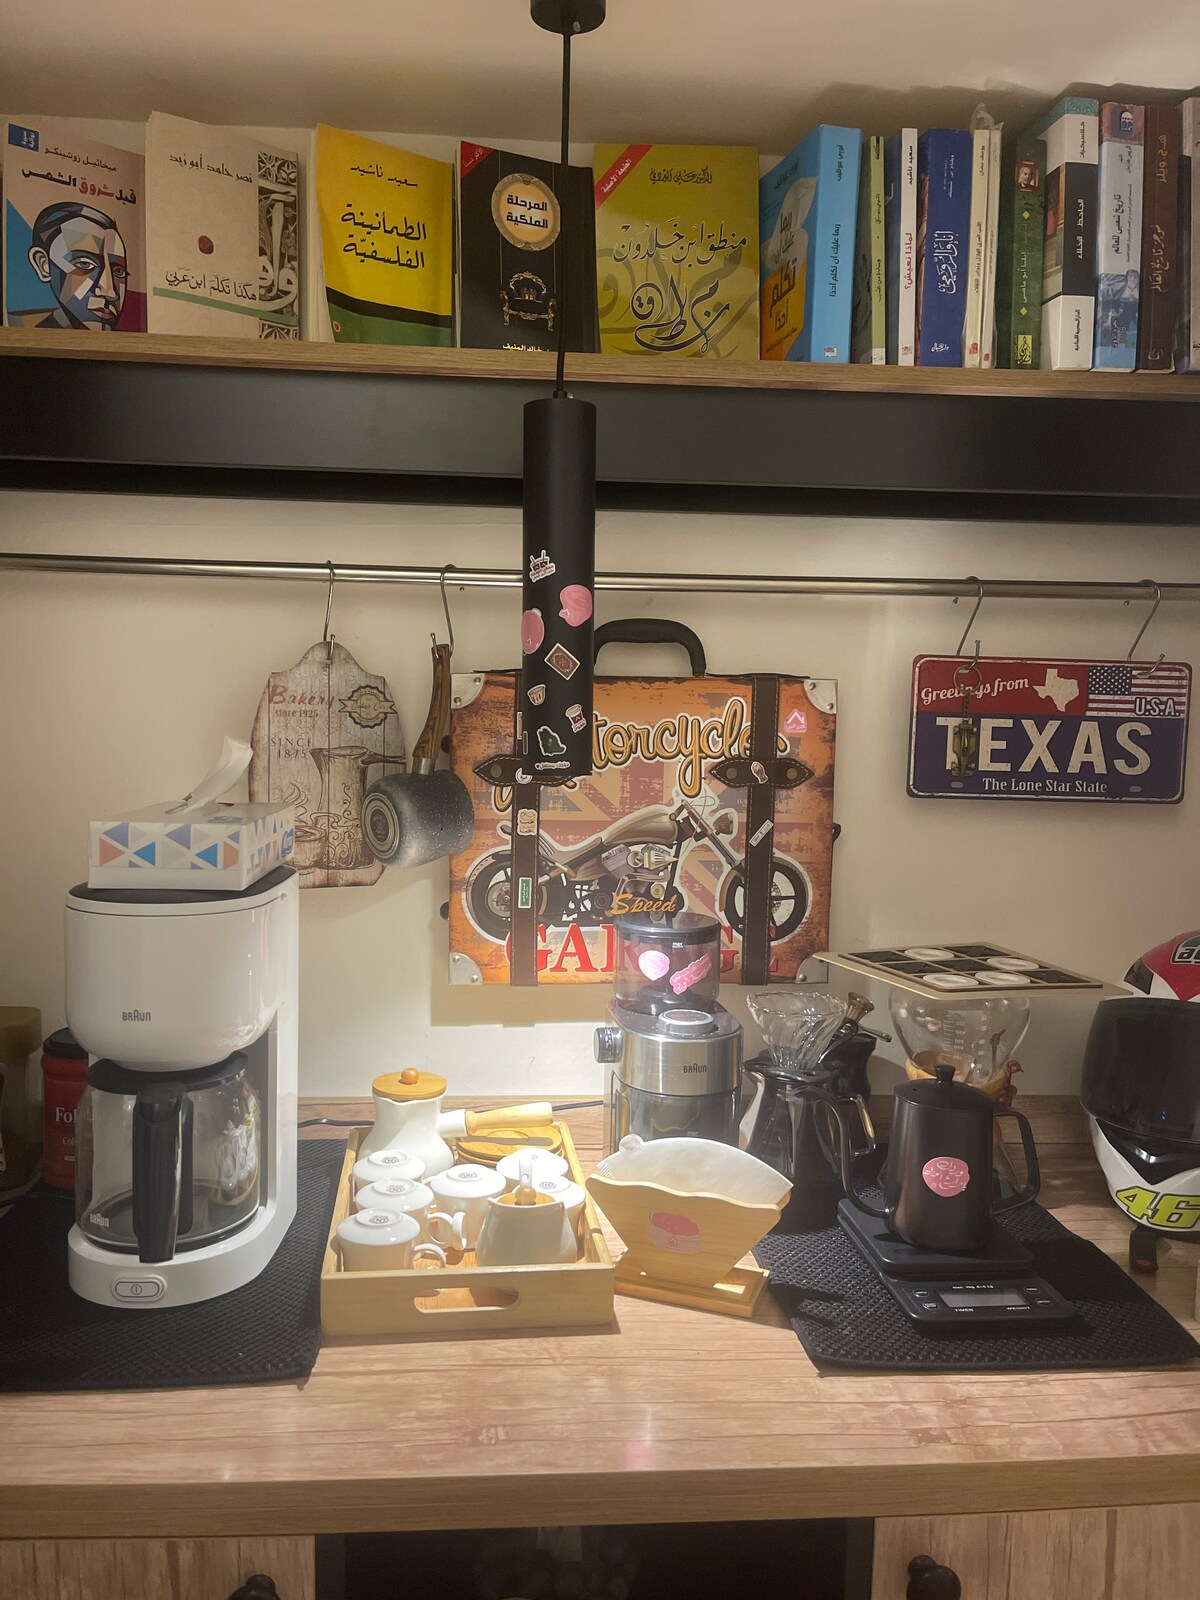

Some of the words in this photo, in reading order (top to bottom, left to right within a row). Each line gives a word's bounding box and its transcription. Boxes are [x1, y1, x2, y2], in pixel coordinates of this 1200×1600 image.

[169, 153, 189, 168] زيد
[189, 153, 204, 168] أبو
[206, 163, 231, 176] حامد
[22, 168, 77, 188] الشمس
[235, 170, 253, 184] نصر
[350, 163, 384, 178] ناشيد
[79, 177, 114, 197] شروق
[387, 176, 418, 188] سعيد
[115, 188, 137, 205] قبل
[505, 194, 548, 212] المرحلة
[340, 203, 427, 241] الطمأنينة
[505, 212, 549, 230] الملكية
[268, 684, 335, 710] Bakery
[920, 684, 991, 705] Greetings
[988, 677, 1030, 697] from
[1134, 696, 1181, 717] U.S.A.
[935, 716, 1153, 776] TEXAS
[982, 777, 1008, 792] The
[1010, 778, 1042, 792] Lone
[1045, 779, 1072, 793] Star
[1075, 779, 1108, 794] State
[610, 892, 676, 915] Speed
[122, 1008, 152, 1022] BRAUN
[683, 1062, 708, 1074] BRAUN
[1115, 1184, 1200, 1230] 46
